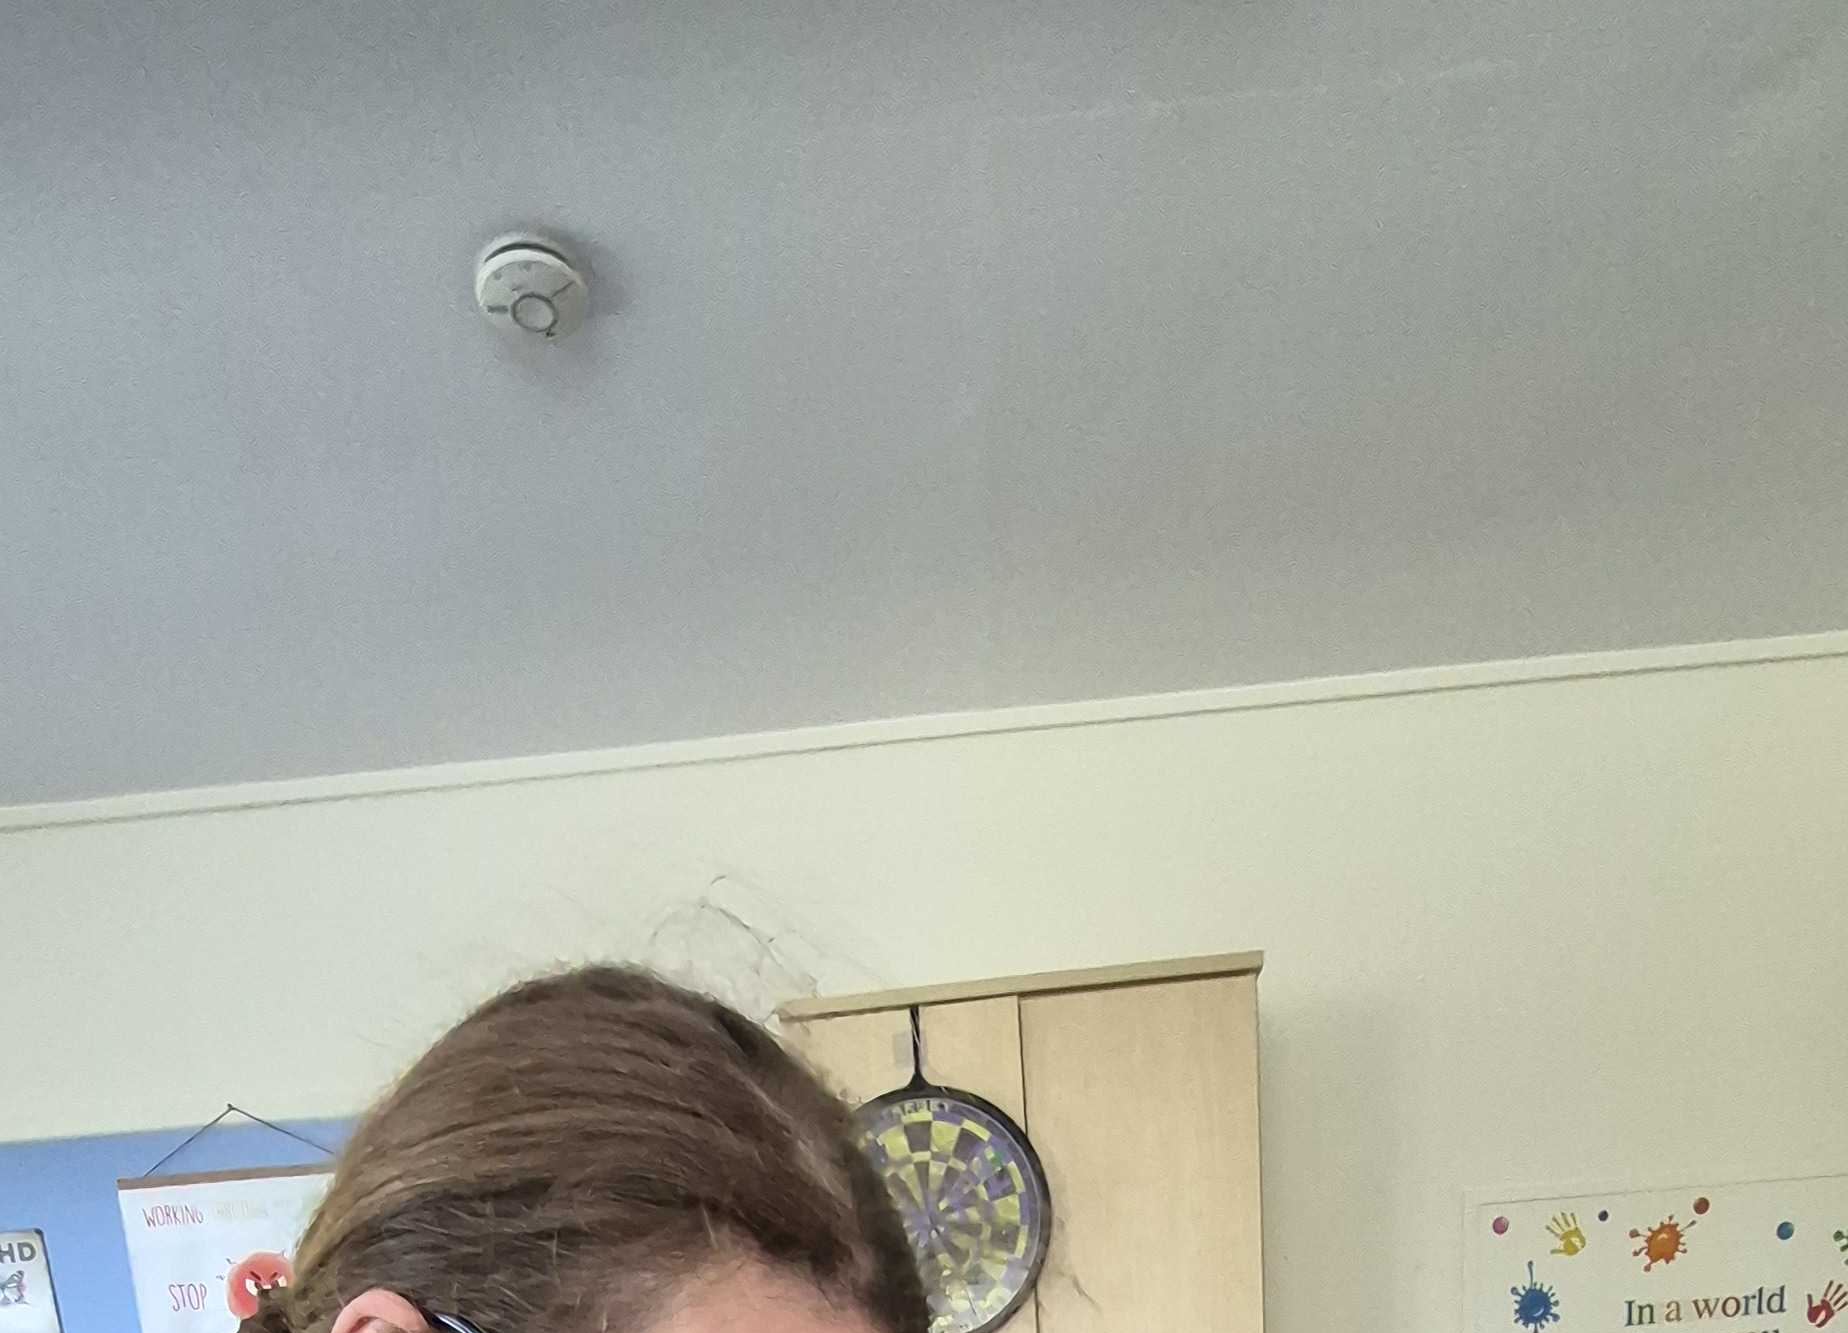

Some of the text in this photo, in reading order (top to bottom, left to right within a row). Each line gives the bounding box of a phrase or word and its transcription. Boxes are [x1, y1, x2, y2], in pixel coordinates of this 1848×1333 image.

[168, 1282, 208, 1312] STOP
[1624, 1285, 1787, 1327] In a world
